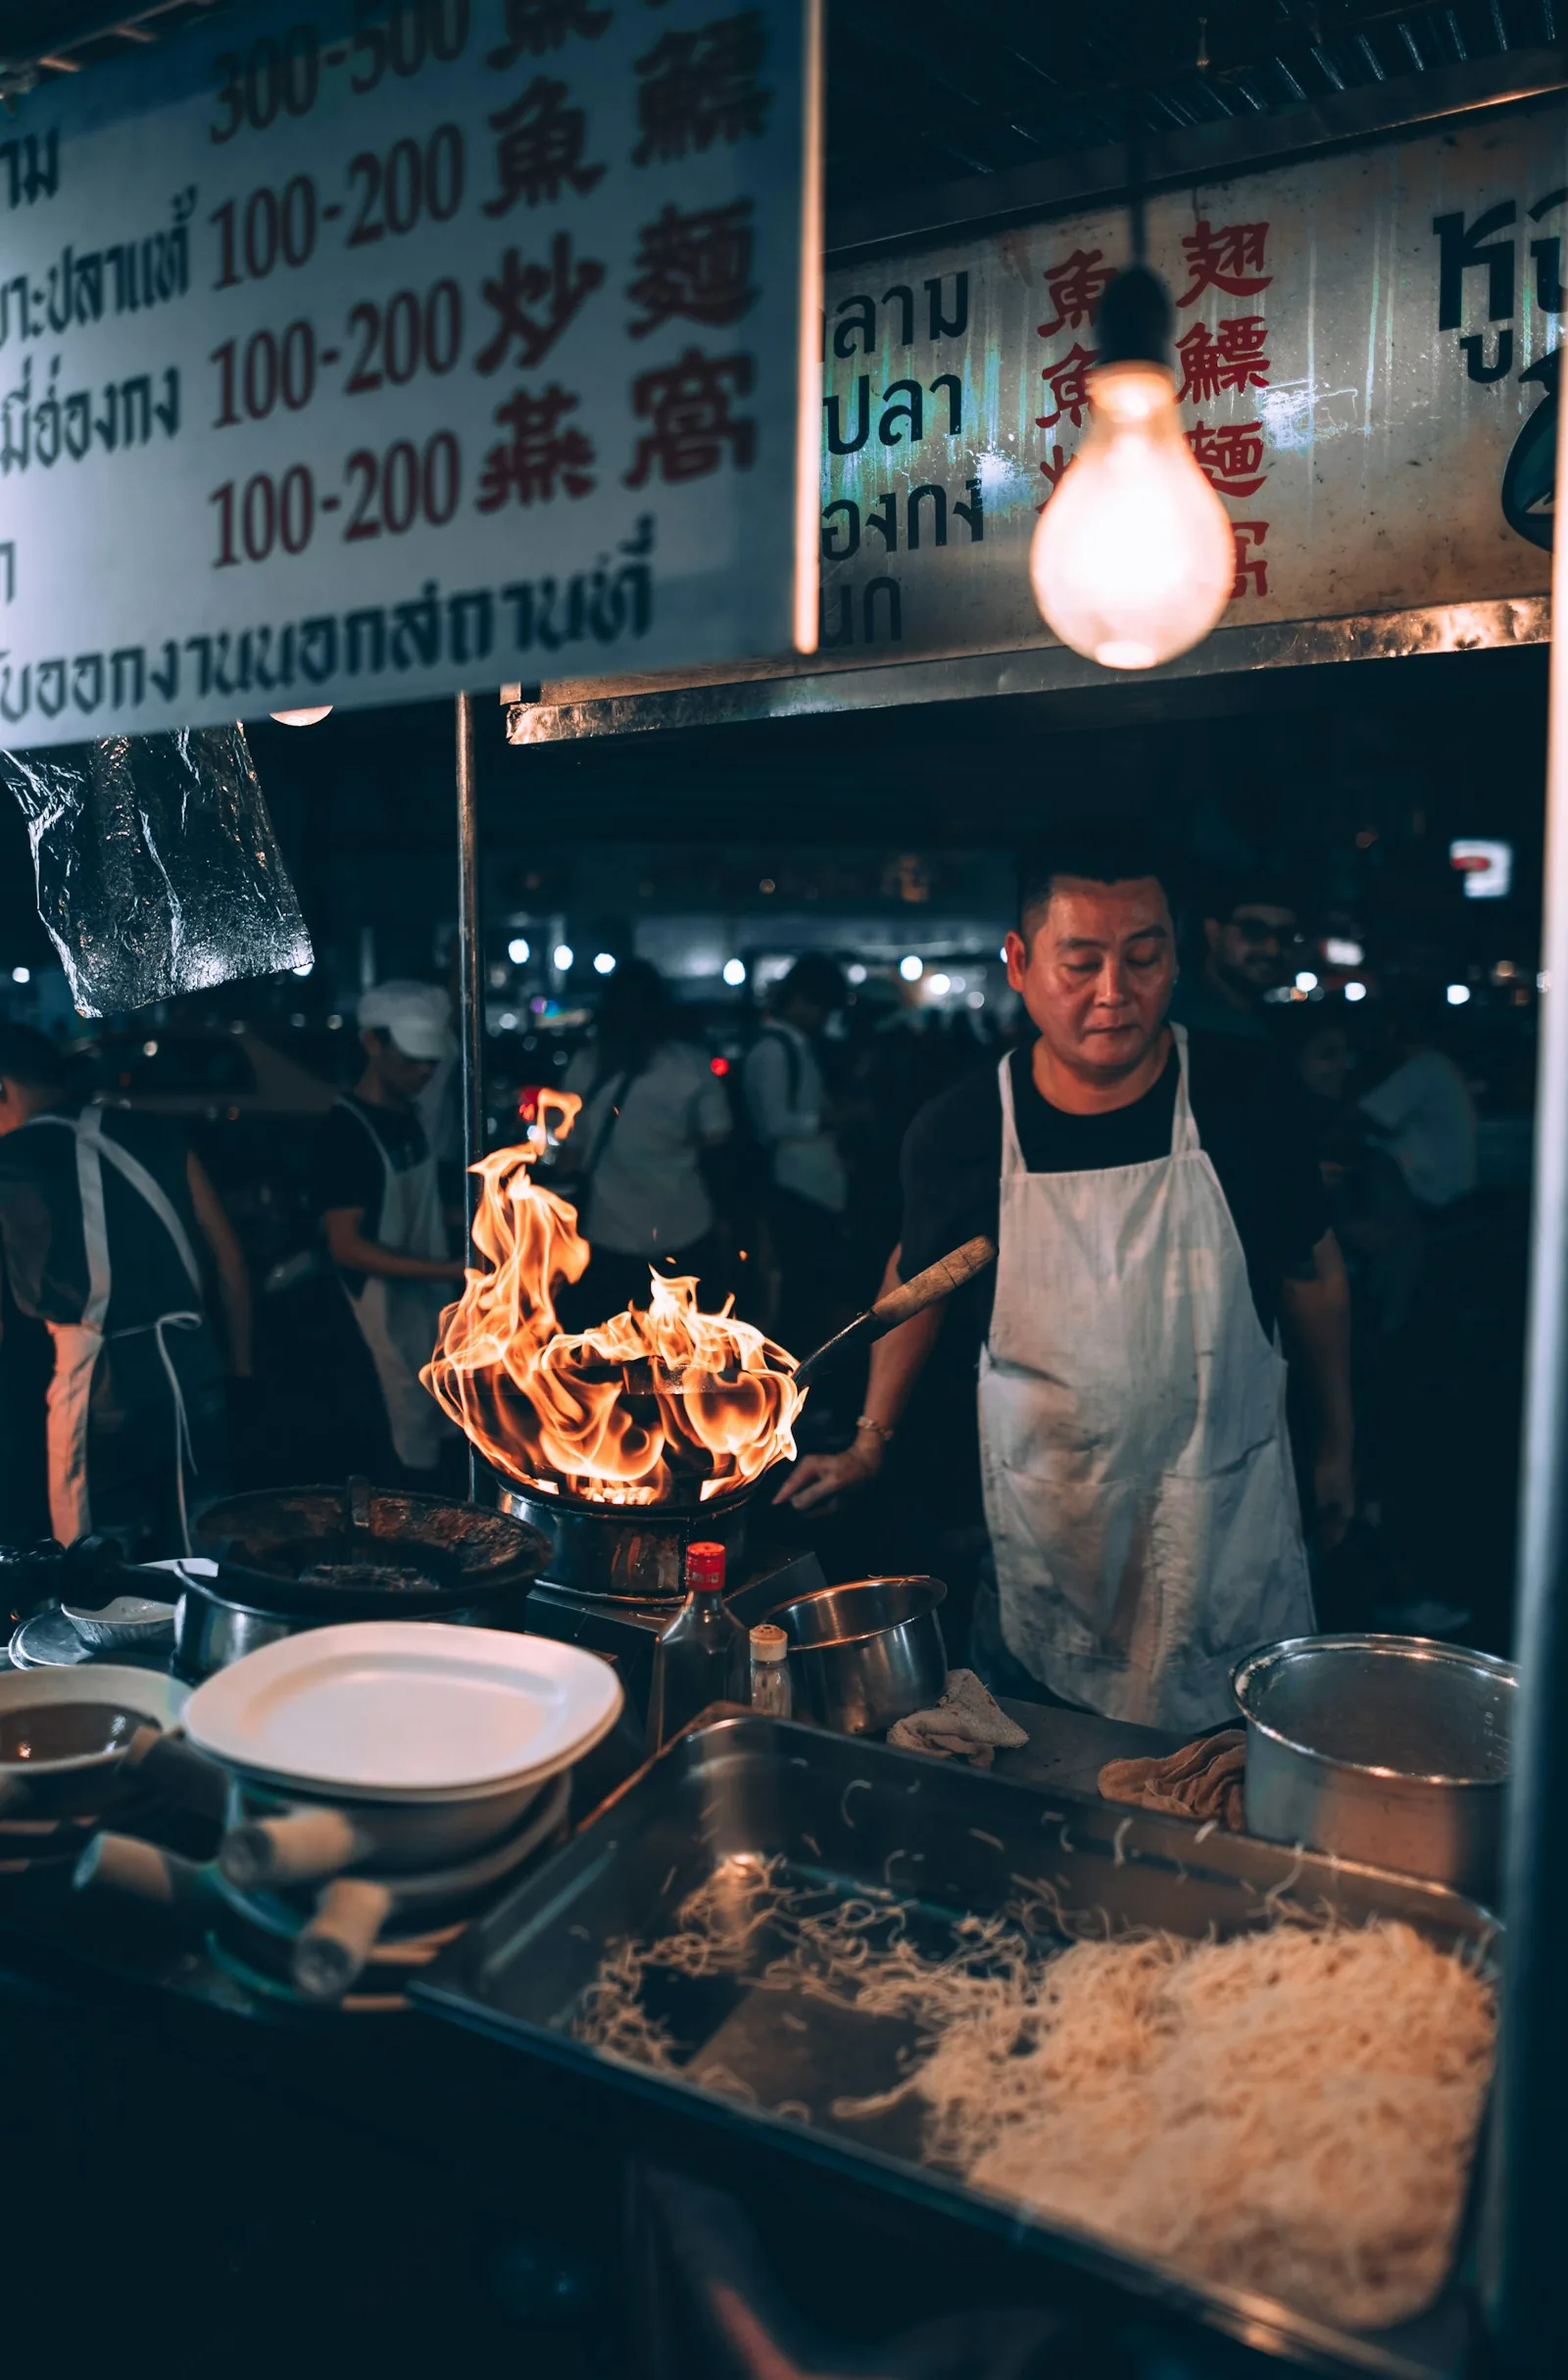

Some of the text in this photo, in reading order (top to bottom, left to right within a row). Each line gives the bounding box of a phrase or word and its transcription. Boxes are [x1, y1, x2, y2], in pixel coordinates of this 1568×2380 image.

[0, 183, 198, 347] าะปลาแท้
[208, 122, 465, 292] 100-200
[208, 276, 463, 429] 100-200
[819, 271, 968, 359] ลาม
[208, 429, 460, 570] 100-200
